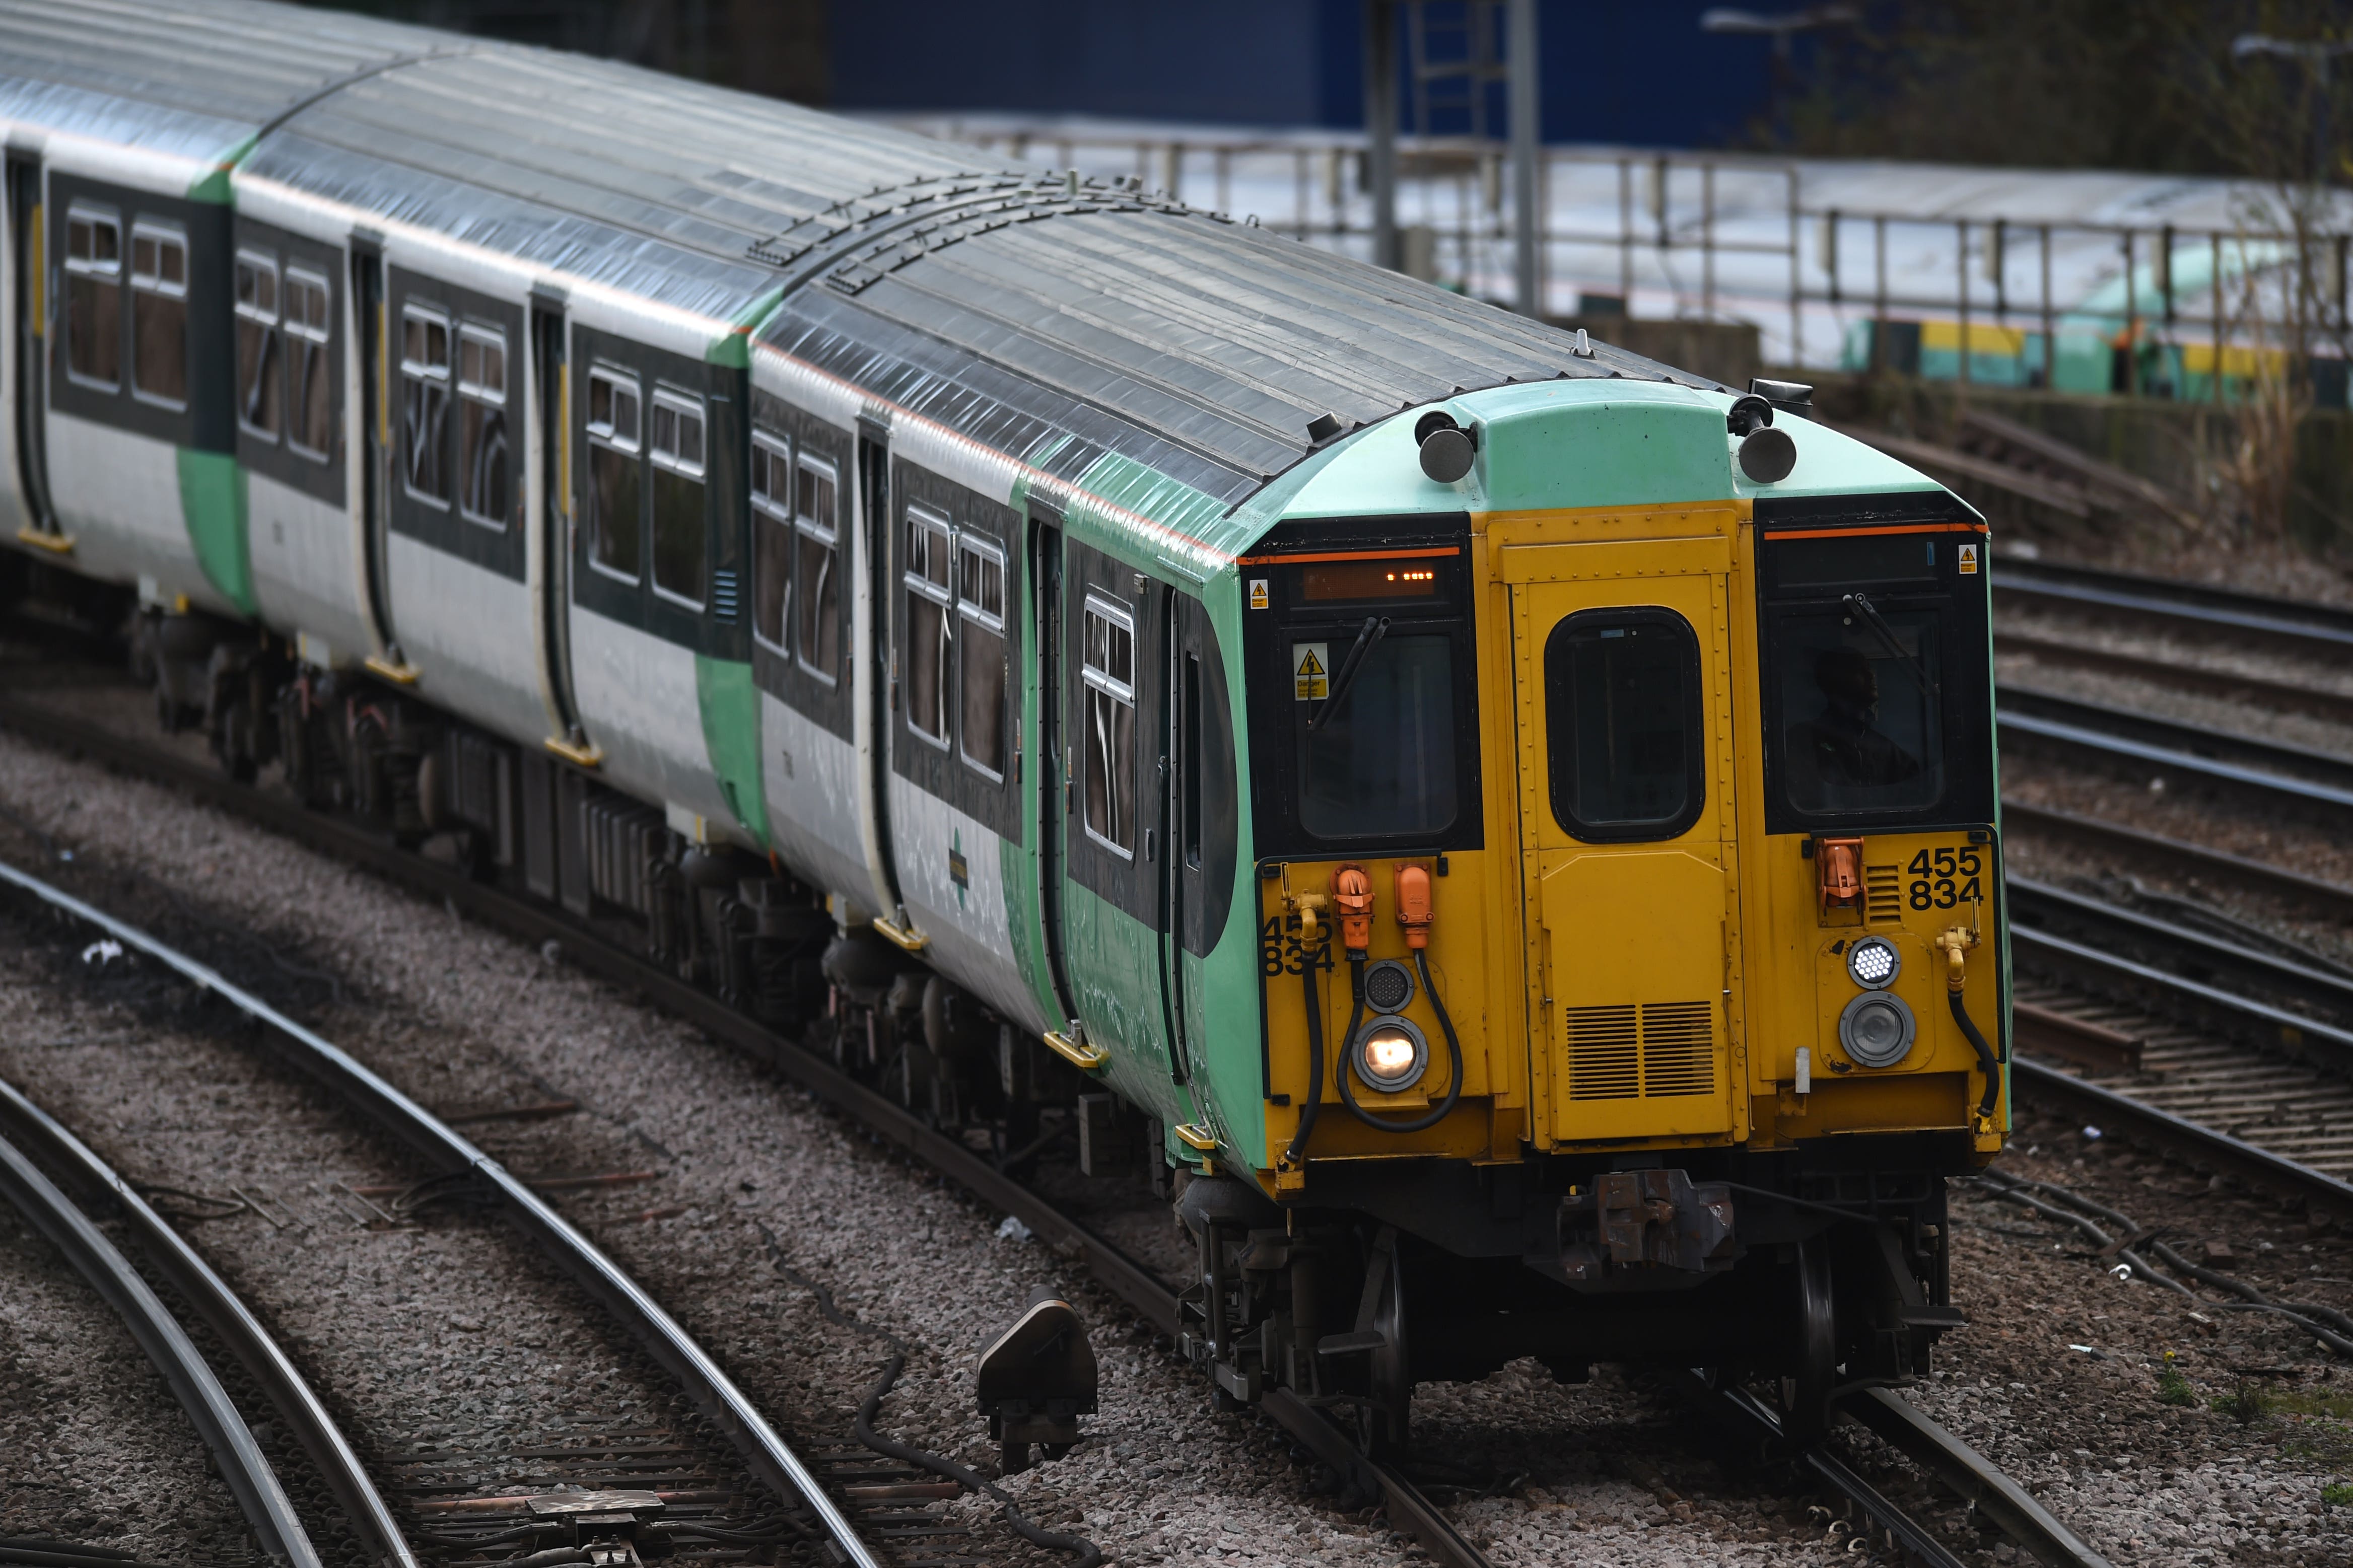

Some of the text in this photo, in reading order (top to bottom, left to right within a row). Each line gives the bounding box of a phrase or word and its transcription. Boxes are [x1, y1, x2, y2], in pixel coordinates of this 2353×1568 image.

[1908, 845, 1981, 879] 455
[1909, 877, 1984, 911] 834
[1264, 943, 1335, 977] 834
